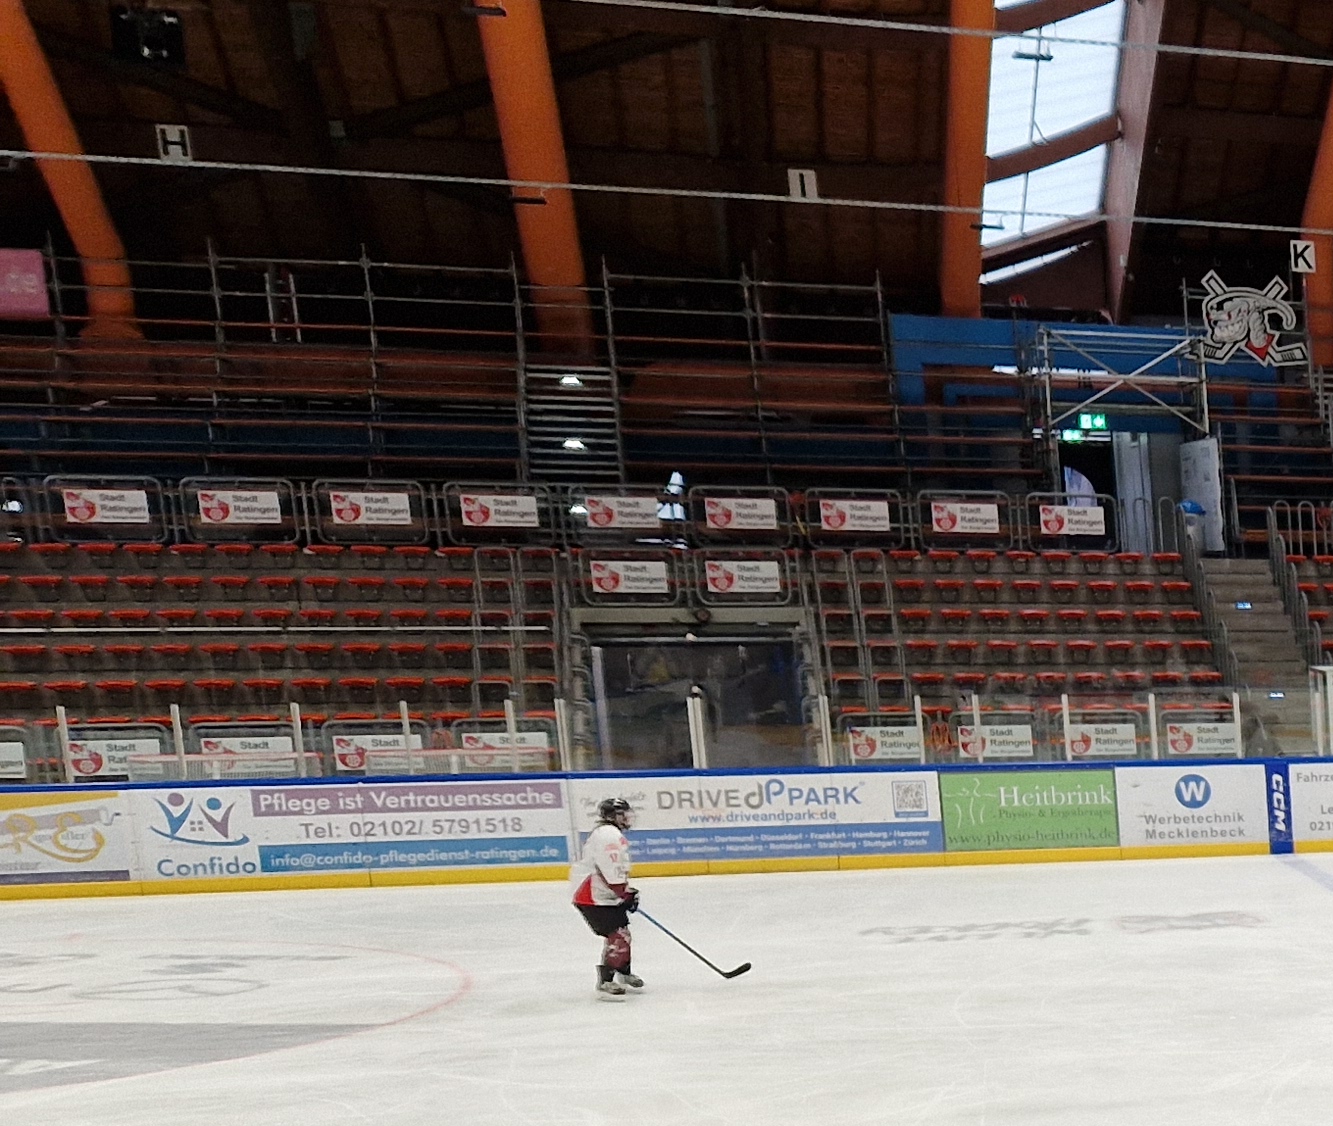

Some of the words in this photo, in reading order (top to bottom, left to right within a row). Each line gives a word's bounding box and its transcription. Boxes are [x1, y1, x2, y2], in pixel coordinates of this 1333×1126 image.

[161, 130, 190, 160] H
[1293, 244, 1313, 270] K
[990, 739, 1031, 748] Ratingen
[1095, 738, 1135, 747] Ratingen
[259, 792, 331, 814] Pflege
[338, 791, 364, 809] ist
[370, 786, 556, 809] Vertrauenssache
[657, 788, 740, 810] DRIVE
[1000, 784, 1113, 808] Heitbrink
[1179, 782, 1207, 800] W
[1271, 773, 1286, 833] CCM
[300, 821, 342, 839] Tel:
[349, 819, 423, 837] 02102/
[432, 816, 523, 835] 5791518
[688, 809, 837, 824] www.driveandpark.de
[1144, 812, 1246, 825] Werbetechnik
[948, 829, 1116, 846] www.physio-heitbrink.de
[1145, 826, 1246, 840] Mecklenbeck
[157, 855, 257, 877] Confido
[270, 846, 559, 868] info@confido-pflegedienst-ratingen.de
